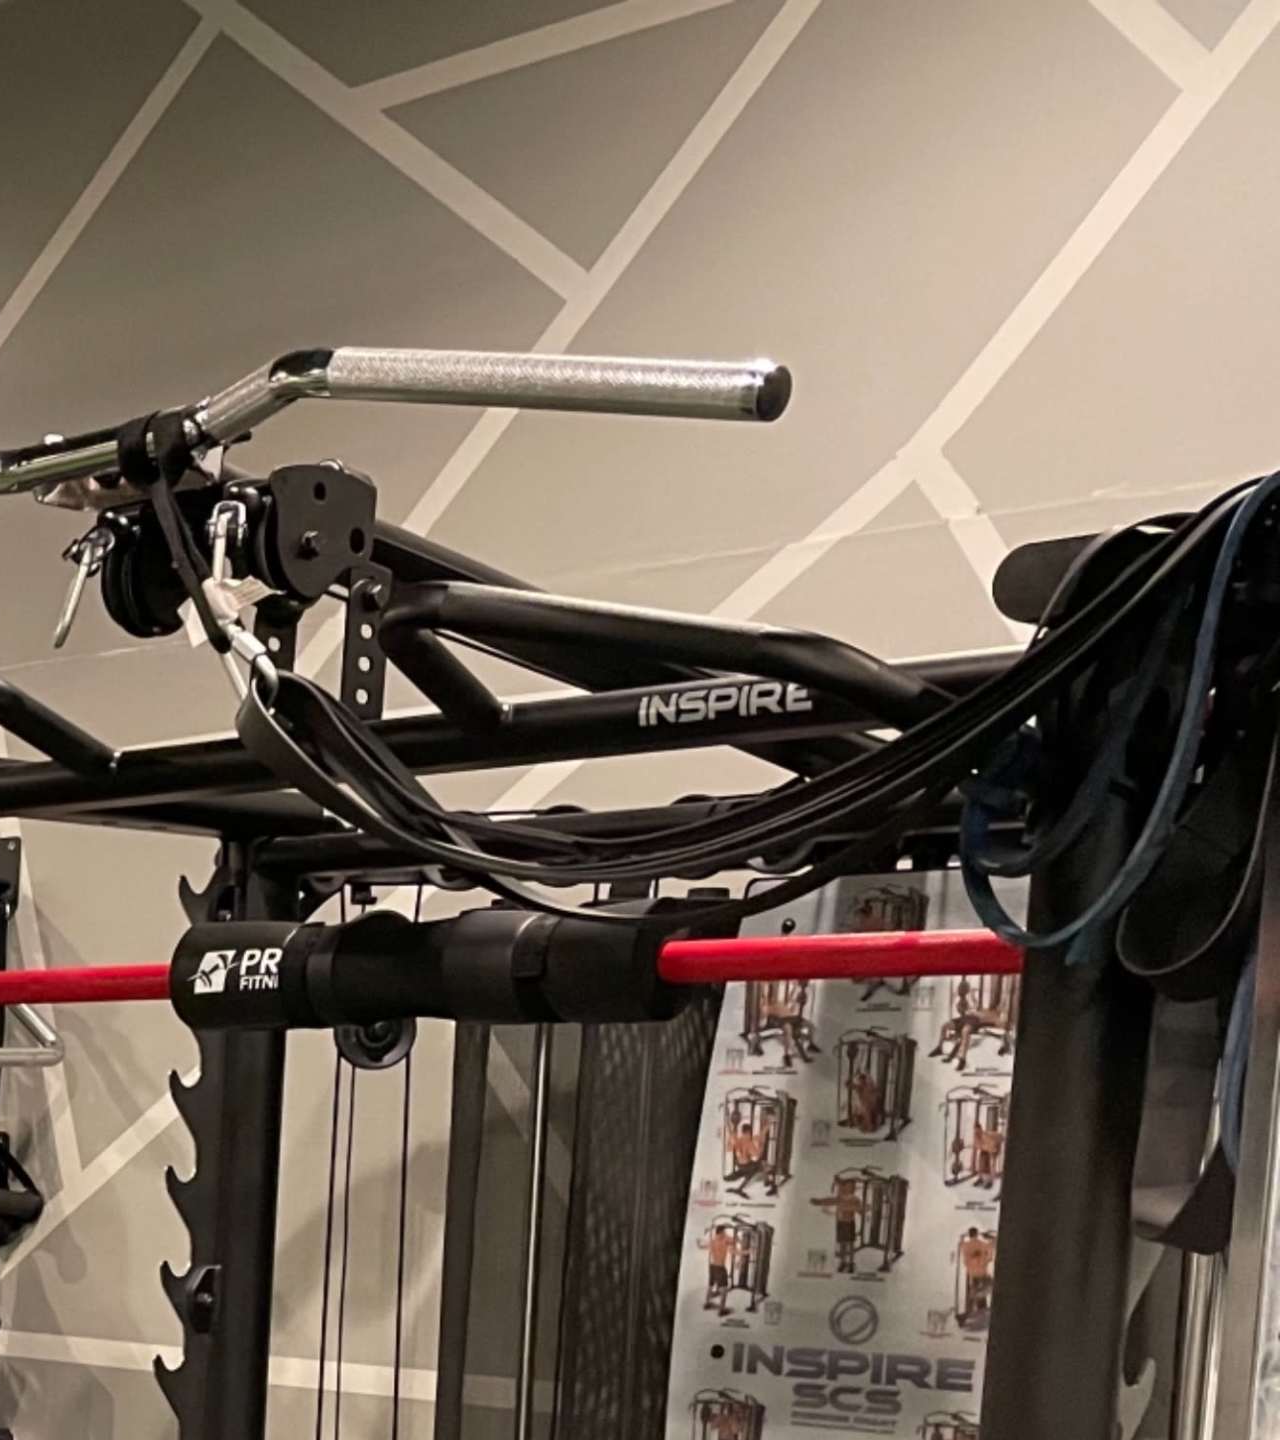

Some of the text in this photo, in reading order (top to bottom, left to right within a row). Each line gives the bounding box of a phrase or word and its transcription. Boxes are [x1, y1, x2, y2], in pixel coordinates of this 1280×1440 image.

[639, 682, 812, 727] INSPIRE
[240, 948, 283, 976] PR
[240, 975, 279, 991] FITN
[732, 1342, 976, 1392] INSPIRE
[792, 1383, 902, 1415] SCS
